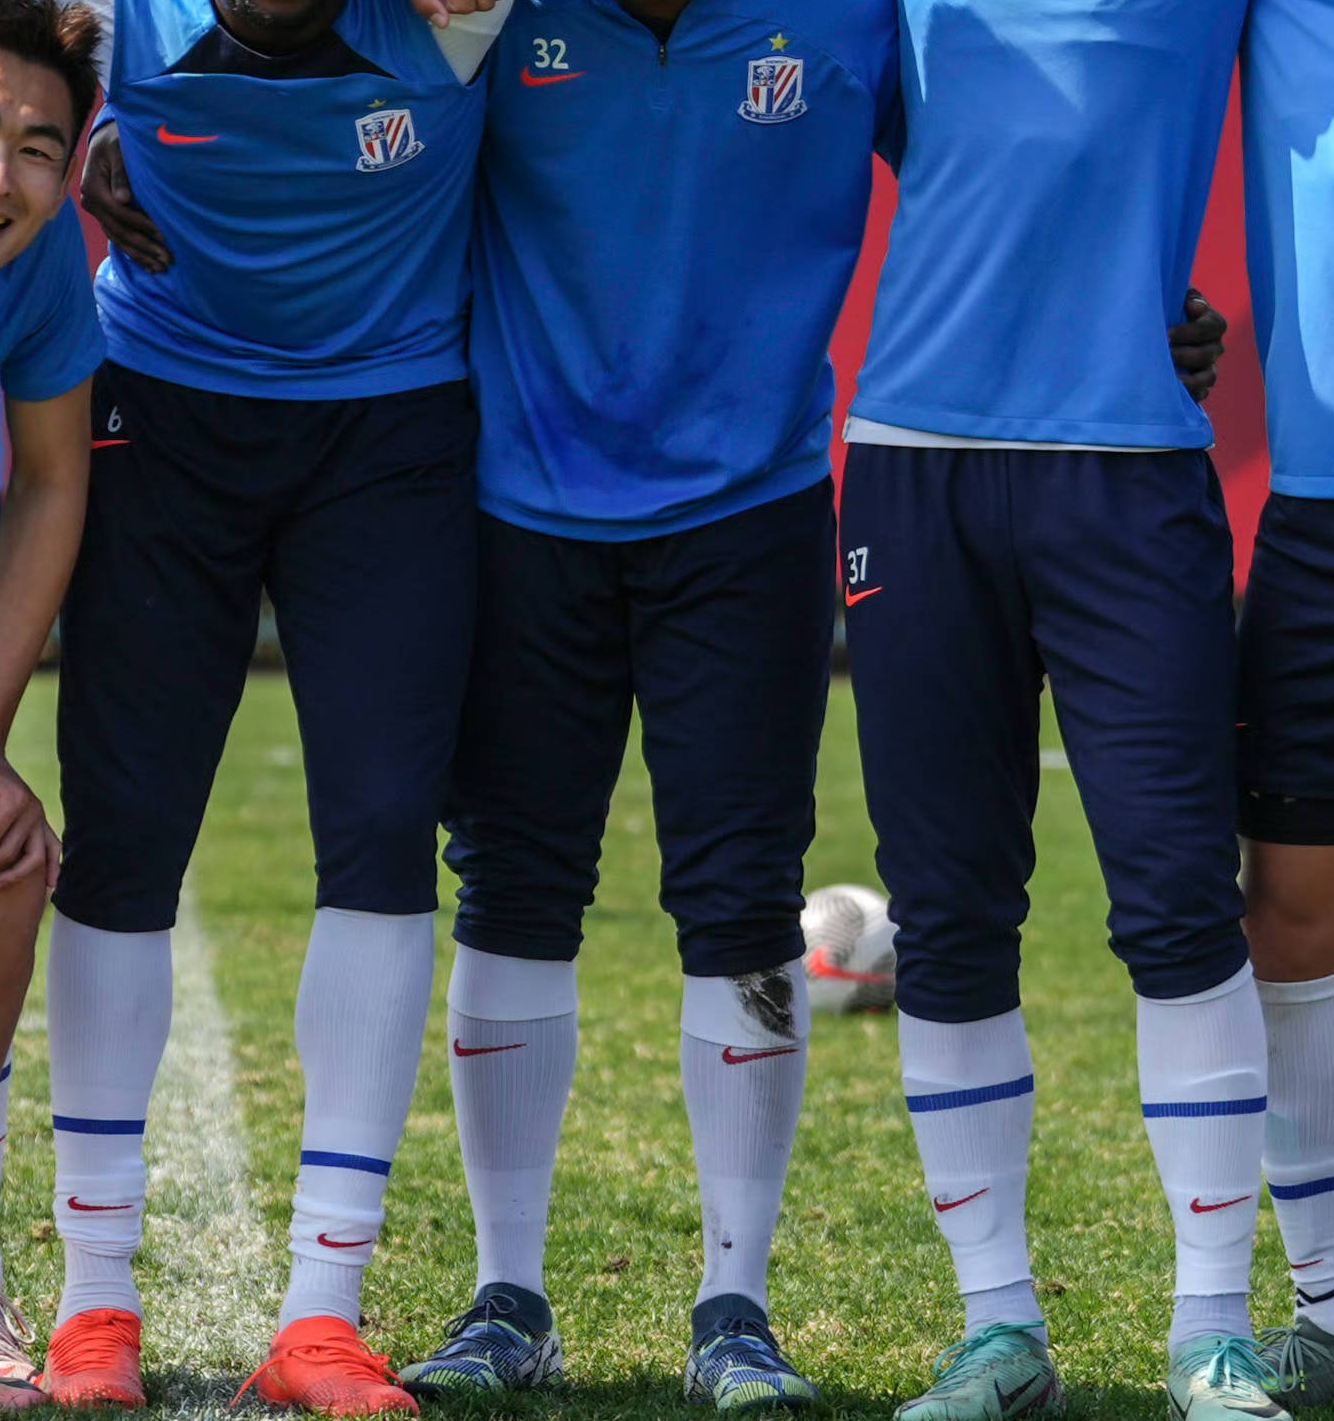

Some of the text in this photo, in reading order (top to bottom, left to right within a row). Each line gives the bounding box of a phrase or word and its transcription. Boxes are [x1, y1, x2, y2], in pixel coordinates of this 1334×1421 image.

[533, 37, 569, 69] 32
[107, 405, 123, 433] 6
[848, 546, 869, 584] 37
